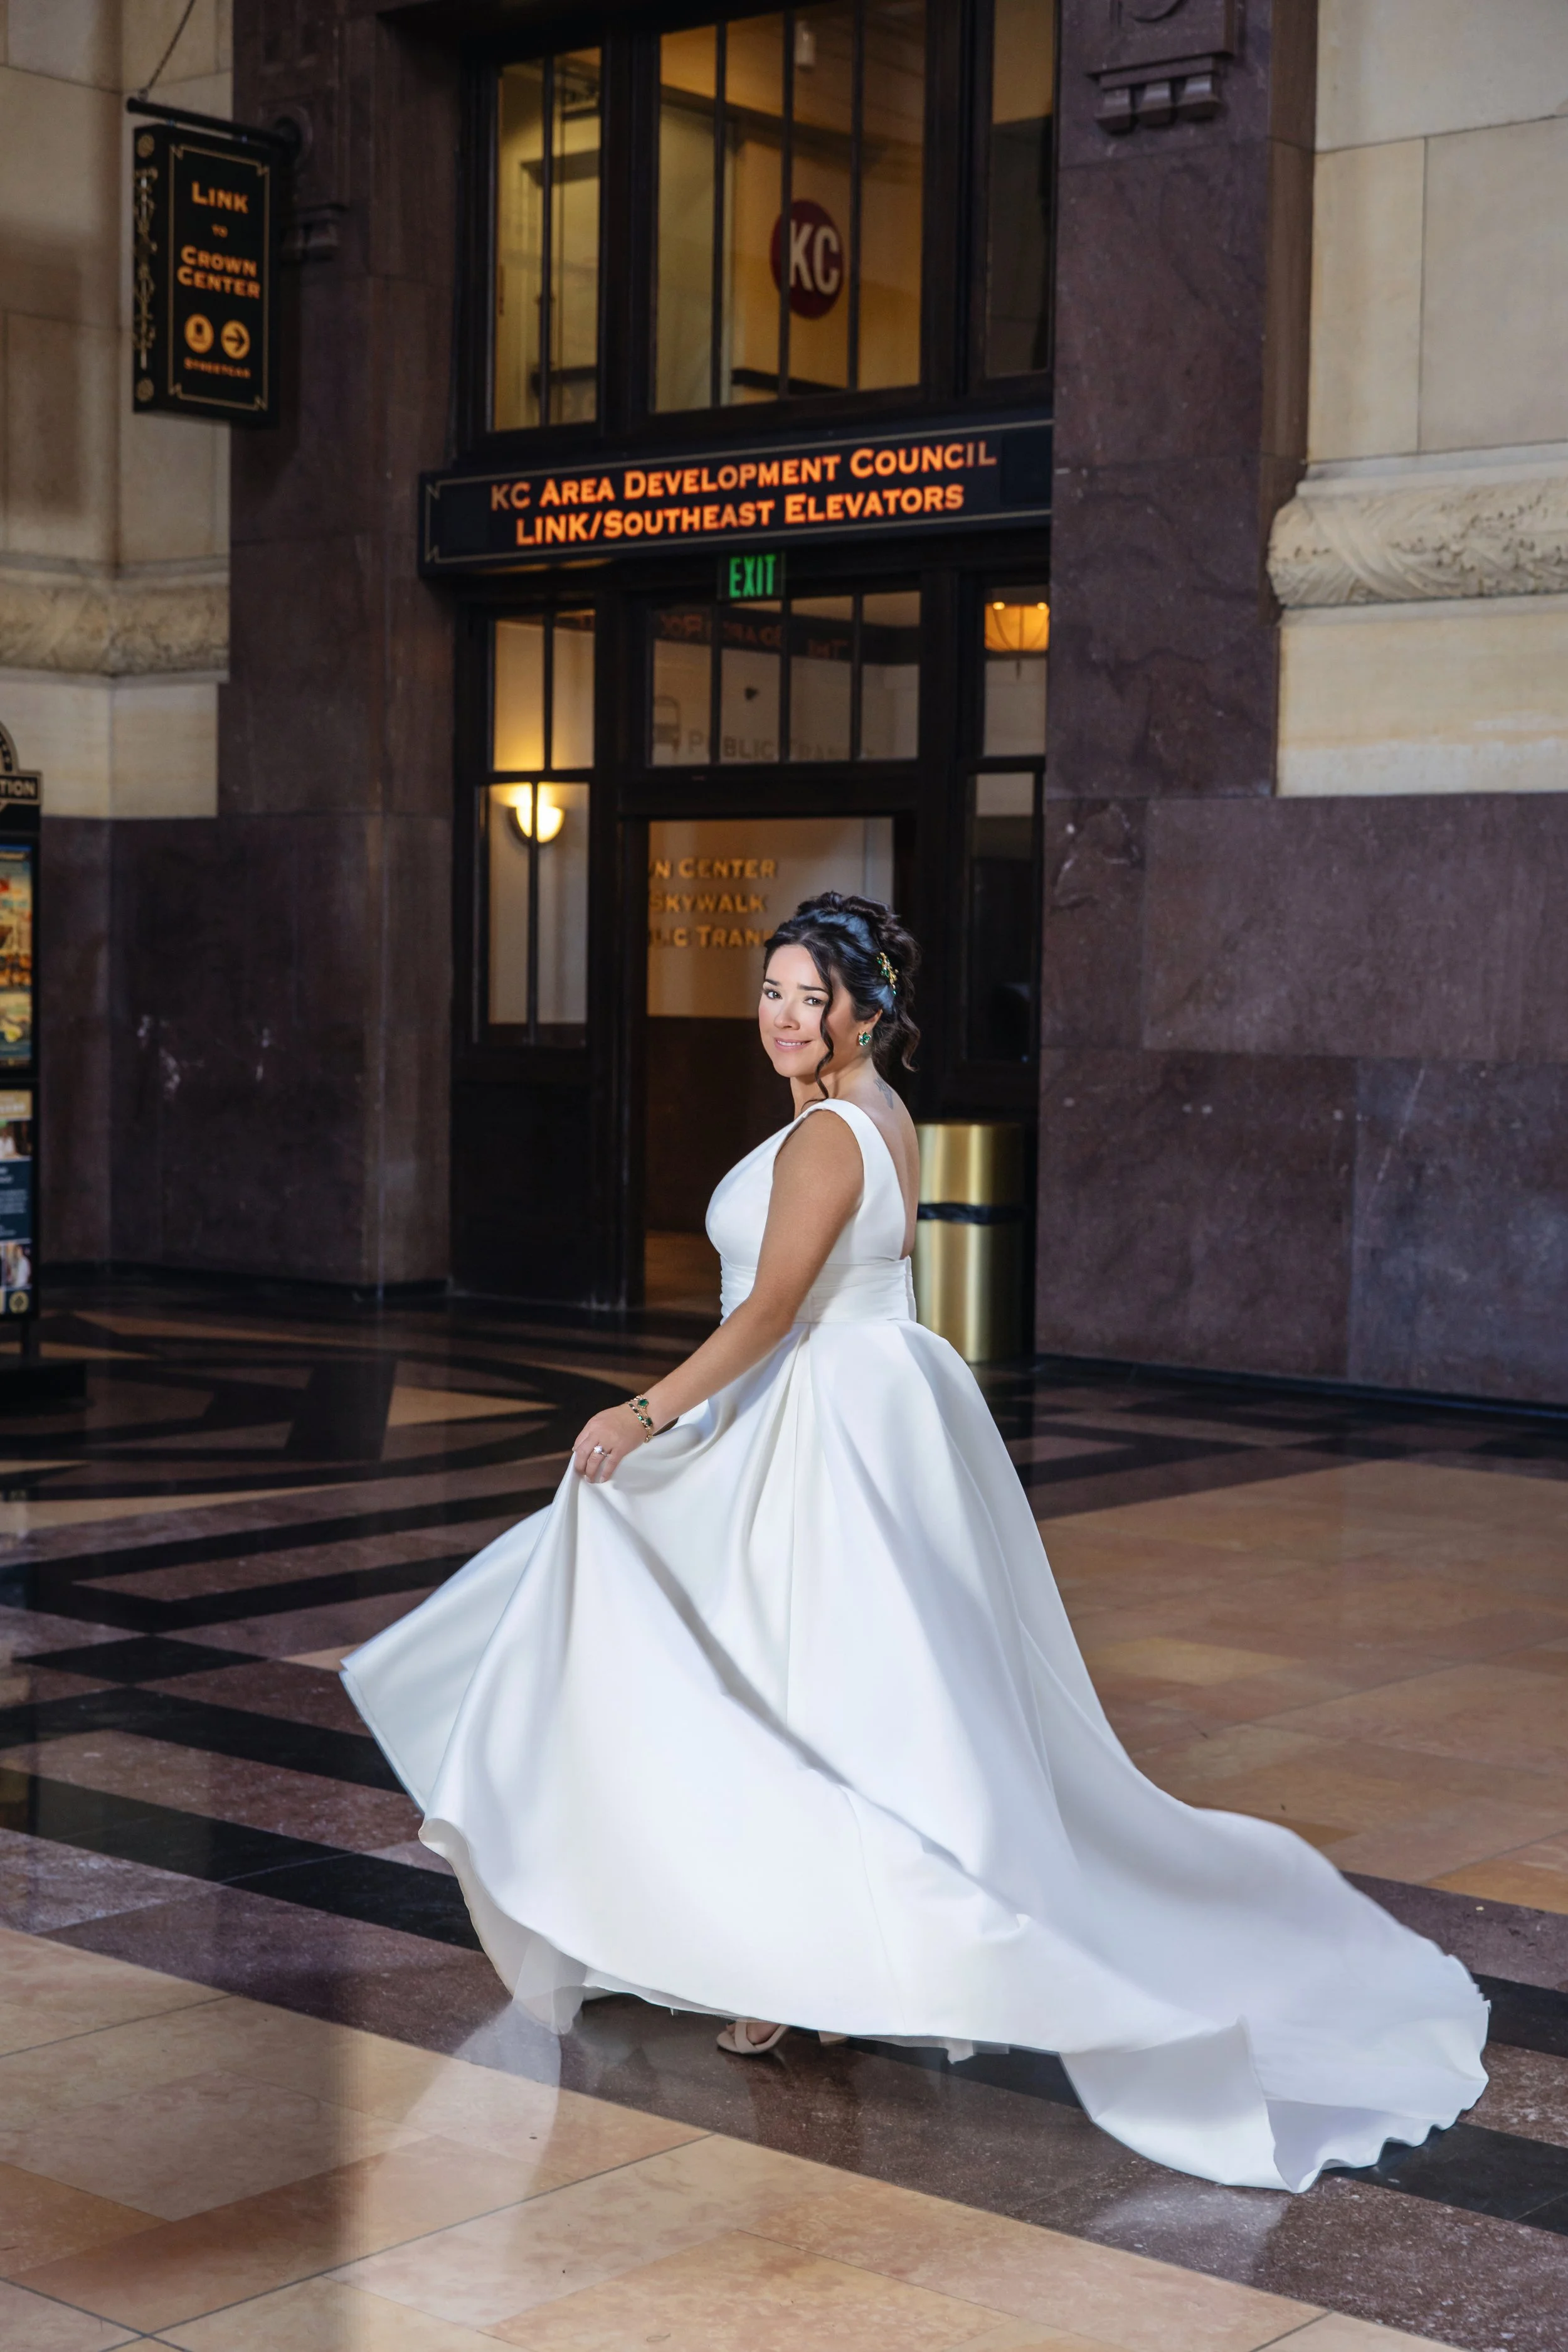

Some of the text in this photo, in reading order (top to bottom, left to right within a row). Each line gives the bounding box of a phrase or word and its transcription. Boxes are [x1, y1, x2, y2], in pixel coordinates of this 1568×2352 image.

[192, 181, 248, 213] LINK
[211, 224, 228, 238] TO
[181, 245, 257, 277] CROWN
[790, 220, 839, 295] KC
[177, 266, 260, 299] CENTER
[491, 441, 997, 511] KC AREA DEVELOPMENT COUNCIL
[516, 484, 965, 546] LINK/SOUTHEAST ELEVATORS
[729, 555, 776, 599] EXIT
[688, 729, 775, 760] PBLIC
[678, 857, 777, 878] CENTER
